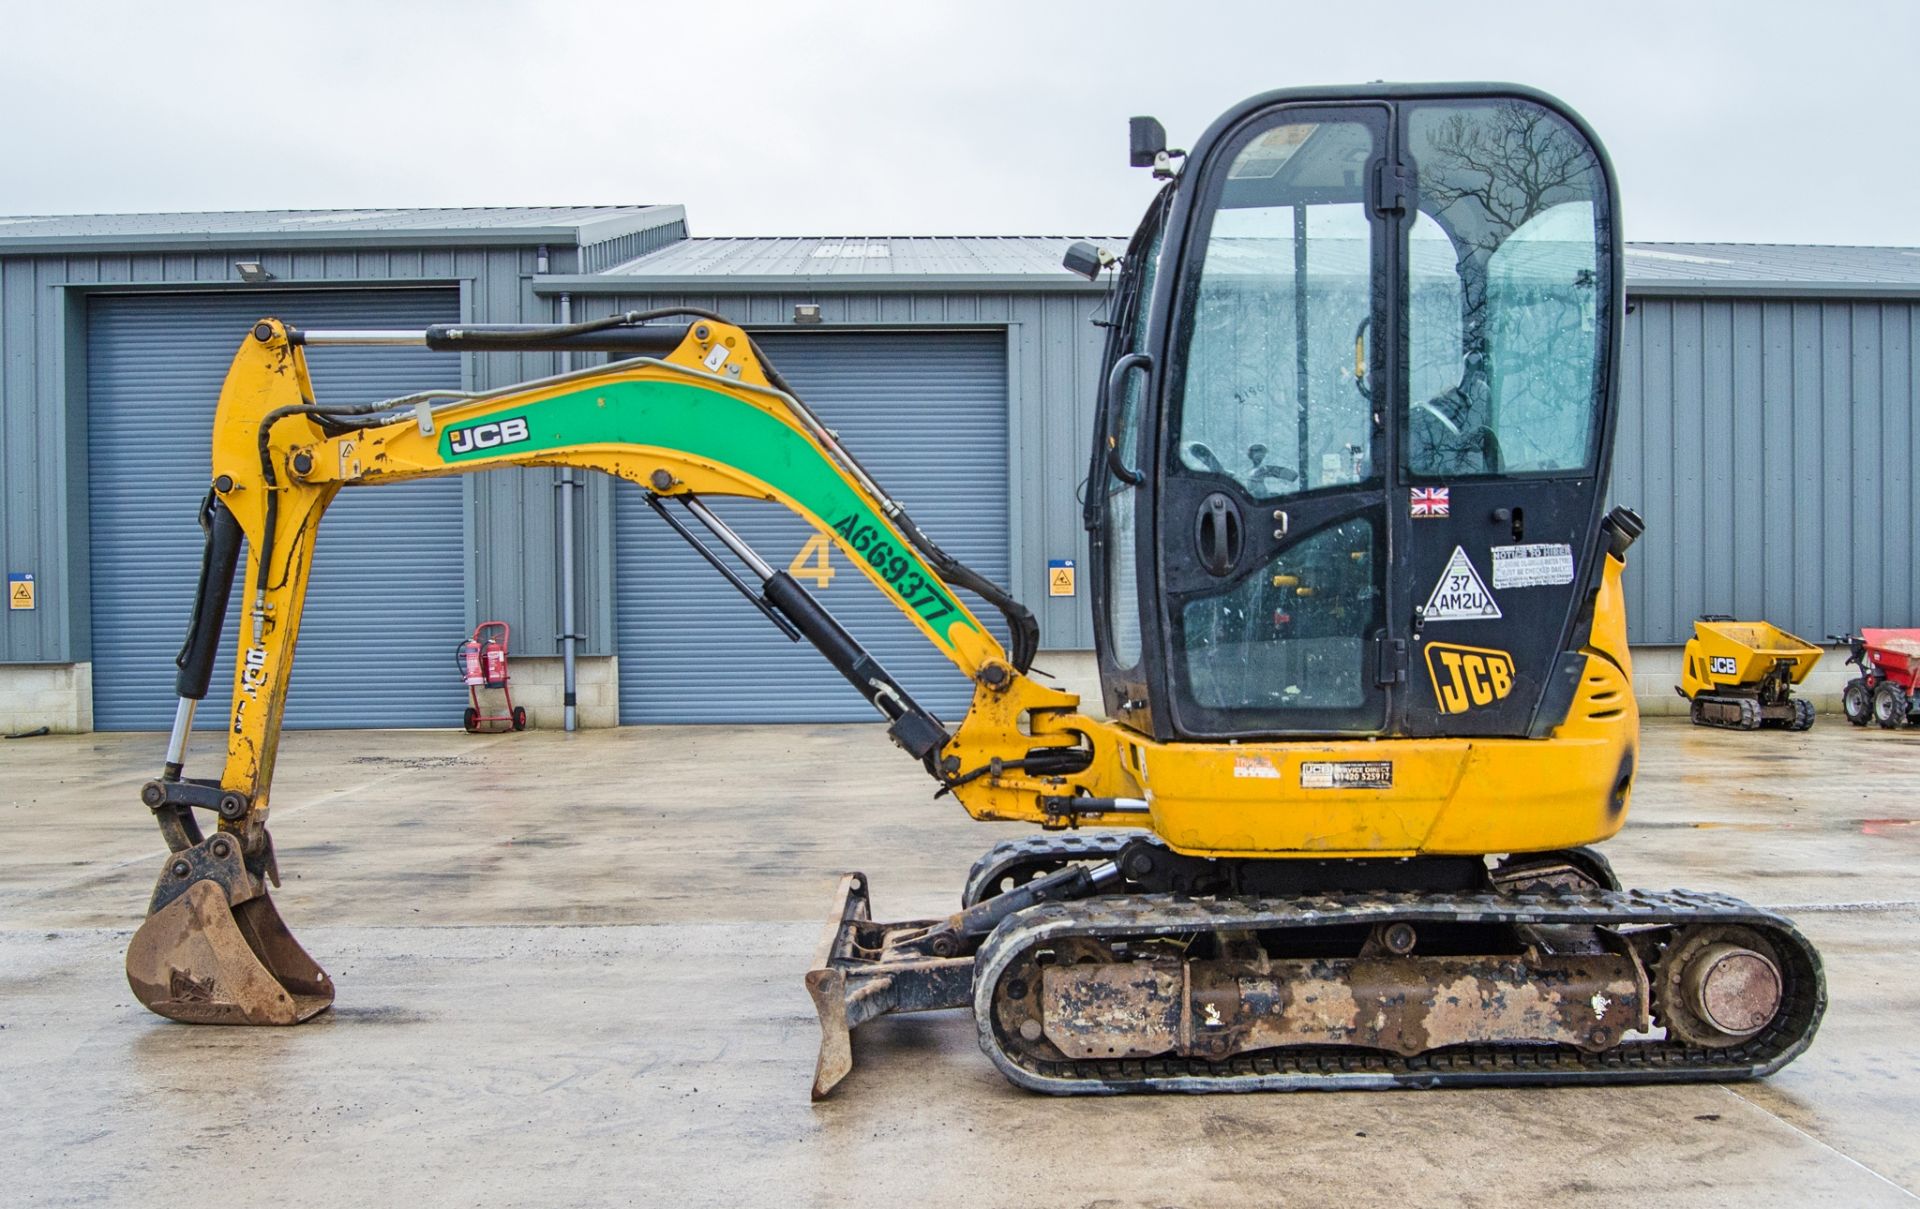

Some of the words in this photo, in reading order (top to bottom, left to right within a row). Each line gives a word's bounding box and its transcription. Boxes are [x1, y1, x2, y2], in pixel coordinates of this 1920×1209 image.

[449, 418, 529, 453] JCB
[788, 534, 836, 589] 4
[833, 512, 955, 622] A669377
[1450, 575, 1470, 592] 37
[1440, 593, 1482, 610] AM2U
[1710, 657, 1736, 674] JCB
[1440, 651, 1512, 714] JCB
[1362, 773, 1390, 781] 525917
